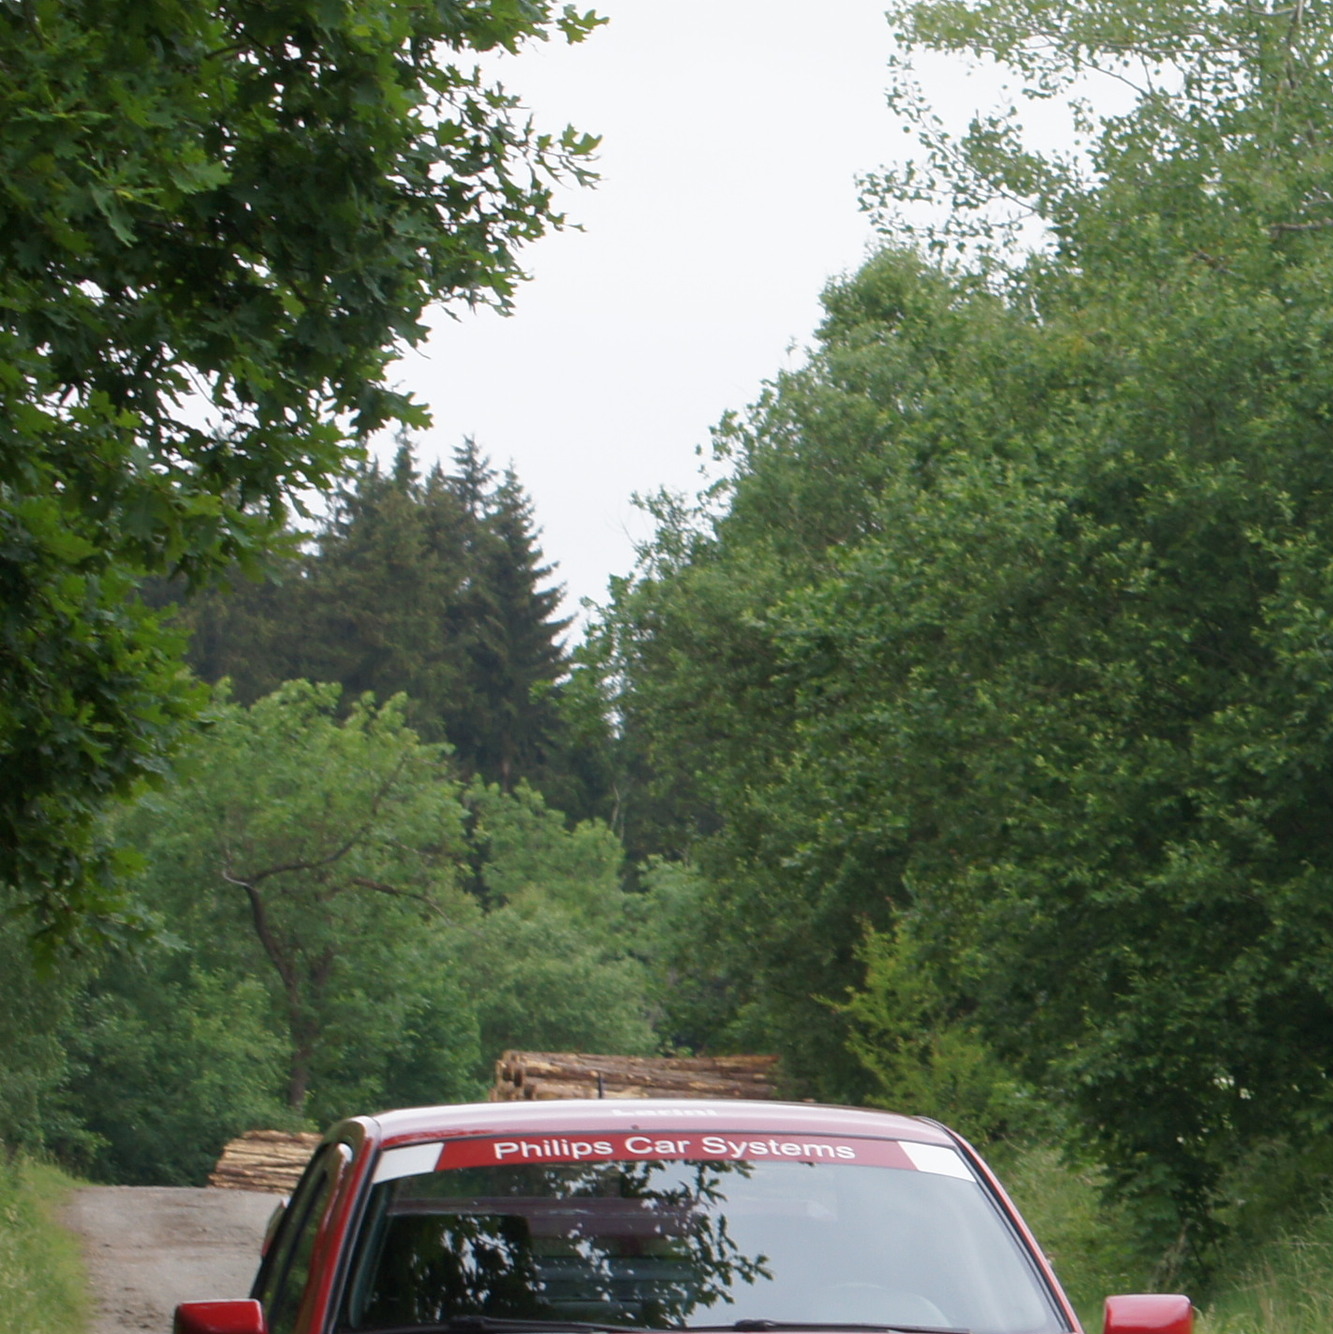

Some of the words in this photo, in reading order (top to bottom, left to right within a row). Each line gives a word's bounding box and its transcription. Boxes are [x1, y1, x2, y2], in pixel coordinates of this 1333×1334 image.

[493, 1136, 614, 1160] Philips
[624, 1135, 691, 1155] Car
[702, 1135, 856, 1160] Systems
